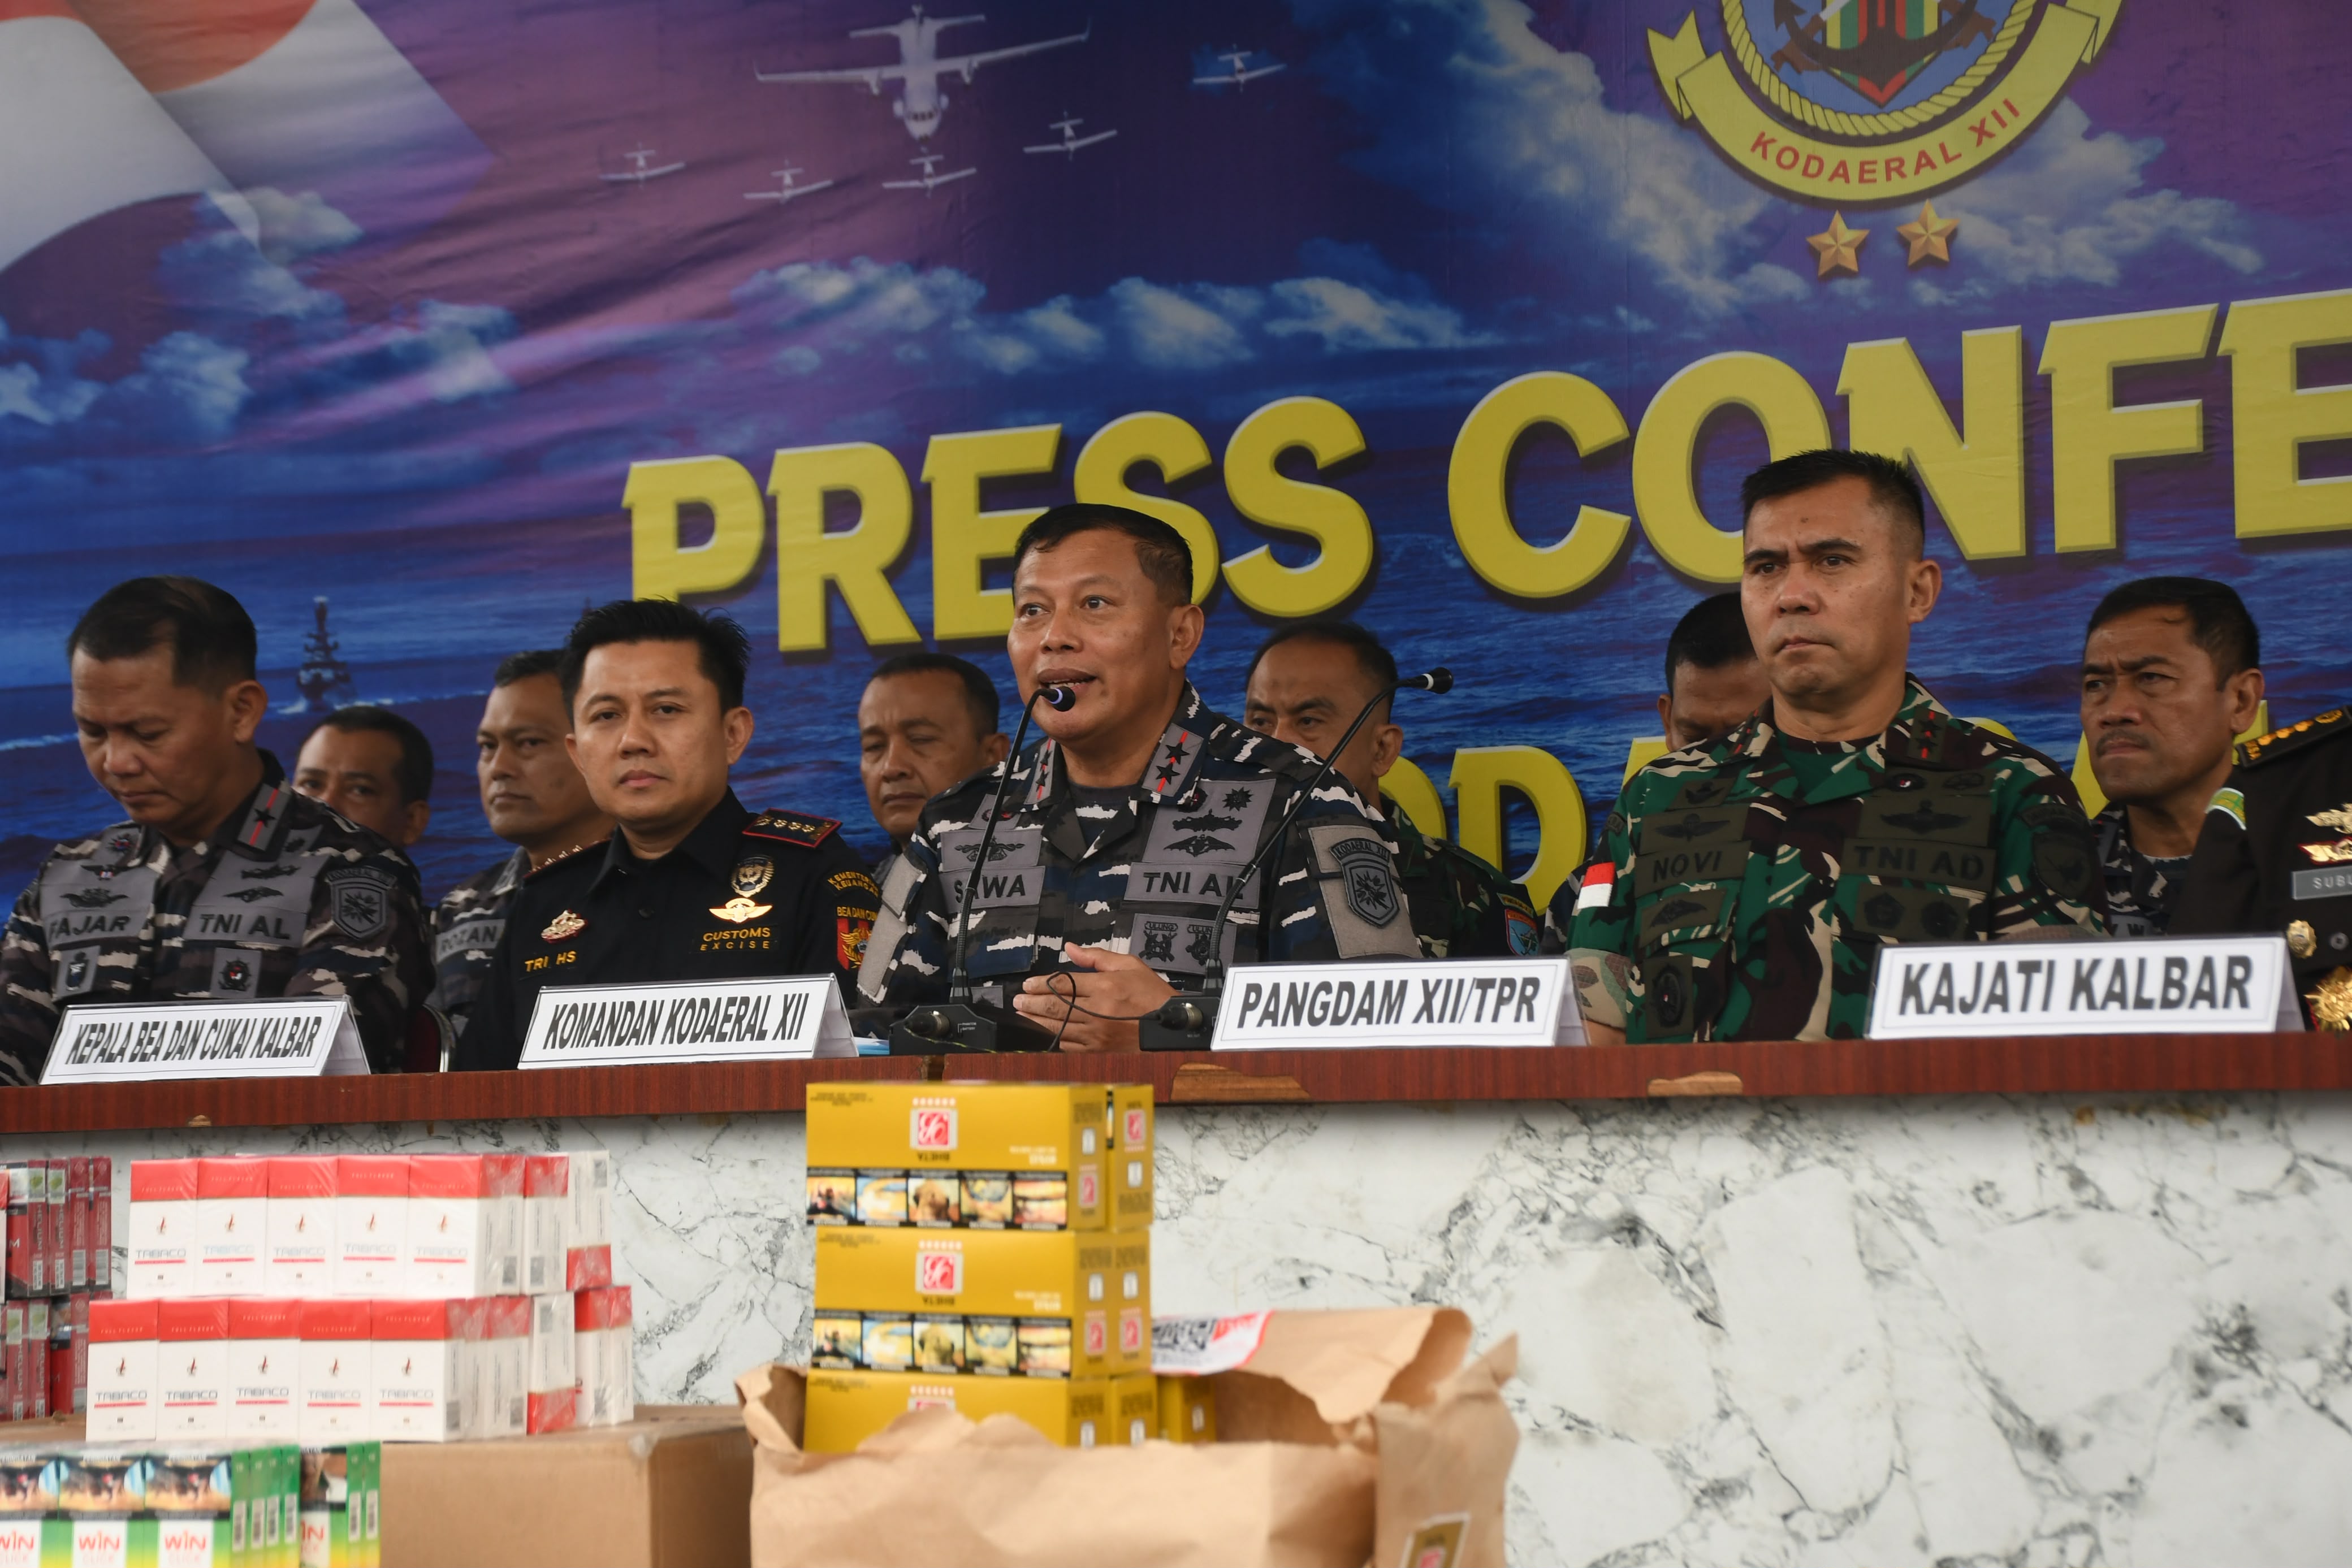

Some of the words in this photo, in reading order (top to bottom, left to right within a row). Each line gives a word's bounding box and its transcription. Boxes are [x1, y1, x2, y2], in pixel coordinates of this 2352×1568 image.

[1749, 131, 1961, 184] KODAERAL
[1968, 98, 2020, 148] XII
[621, 395, 1374, 652] PRESS
[1447, 287, 2352, 598] CONFE
[1335, 840, 1373, 856] KODAERAL
[1652, 850, 1723, 882] NOVI
[1854, 844, 1917, 872] TNI
[1929, 850, 1984, 881] AD
[954, 874, 1026, 903] SWA
[1143, 872, 1191, 893] TNI
[1199, 873, 1243, 900] AL
[837, 907, 851, 917] BEA
[49, 916, 131, 939] FAJAR
[200, 913, 243, 933] TNI
[248, 915, 290, 939] AL
[703, 927, 771, 942] CUSTOMS
[699, 940, 769, 951] EXCISE
[524, 955, 548, 973] TRI
[556, 950, 577, 965] HS
[1898, 960, 2057, 1016] KAJATI
[2069, 955, 2253, 1012] KALBAR
[1237, 978, 1409, 1028] PANGDAM
[1412, 976, 1541, 1024] XII/TPR
[543, 999, 664, 1050] KOMANDAN
[660, 994, 771, 1045] KODAERAL
[772, 992, 810, 1041] XII
[65, 1023, 129, 1064] KEPALA
[130, 1021, 166, 1063] BEA
[165, 1020, 204, 1062] DAN
[198, 1017, 256, 1061] CUKAI
[249, 1016, 322, 1060] KALBAR
[135, 1248, 187, 1258] TABACO
[96, 1391, 147, 1401] TABACO
[165, 1391, 217, 1401] TABACO
[236, 1387, 289, 1397] TABACO
[379, 1389, 434, 1399] TABACO
[79, 1531, 120, 1550] WIN
[165, 1531, 206, 1550] WIN
[300, 1519, 324, 1541] IN
